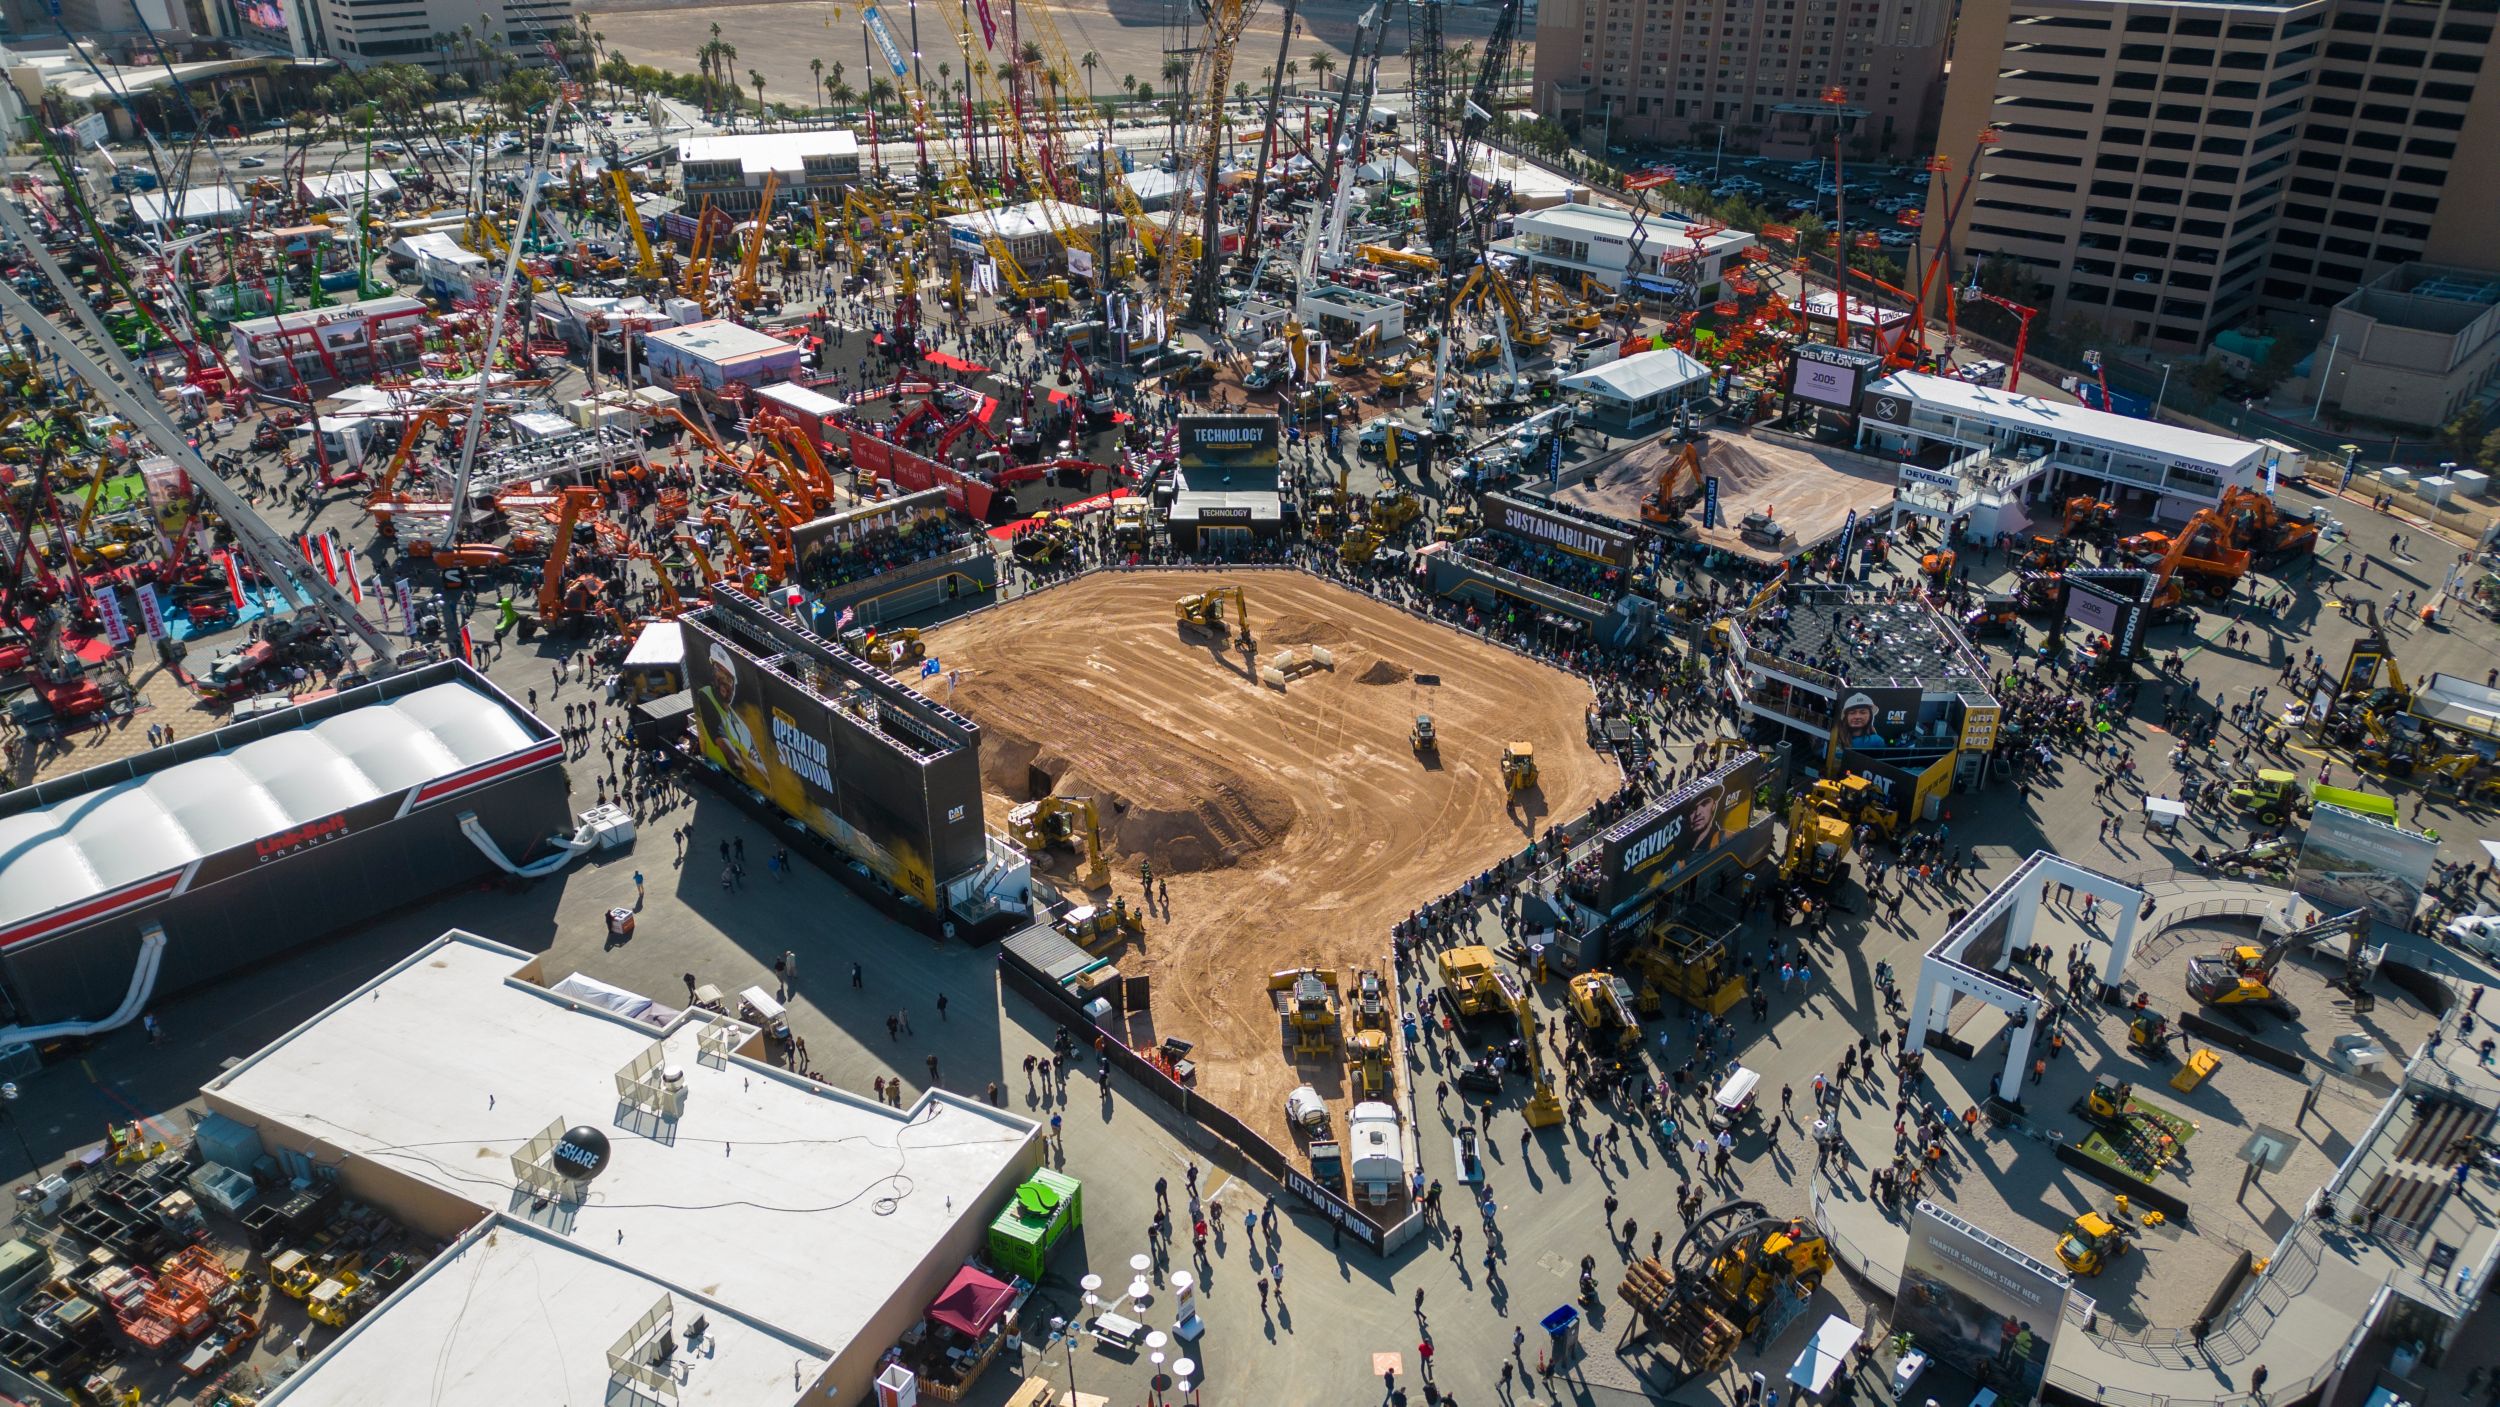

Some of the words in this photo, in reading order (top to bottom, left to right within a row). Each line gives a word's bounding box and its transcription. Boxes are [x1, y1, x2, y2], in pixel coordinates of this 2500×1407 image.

[1594, 235, 1623, 245] LIEBHERR
[1794, 300, 1832, 316] DNGLI
[1800, 350, 1853, 368] DEVELON
[1590, 381, 1608, 393] Altec
[1812, 372, 1836, 385] 2005
[1194, 428, 1263, 442] TECHNOLOGY
[2013, 424, 2053, 438] DEVELON
[1905, 469, 1952, 486] DEVELON
[2174, 460, 2219, 475] DEVELON
[1202, 509, 1248, 517] TECHNOLOGY
[1705, 479, 1716, 527] DEVELON
[1505, 508, 1607, 557] SUSTAINABILITY
[1838, 513, 1855, 563] DEVELON
[99, 594, 121, 641] Link-Belt
[140, 592, 161, 638] Link-Belt
[2082, 601, 2102, 614] 2005
[352, 613, 377, 636] GUAY
[2120, 606, 2140, 657] DOOSAN
[1887, 710, 1907, 721] CAT
[773, 716, 828, 768] OPERATOR
[776, 740, 833, 795] STADIUM
[1725, 790, 1742, 807] CAT
[948, 805, 964, 820] CAT
[255, 815, 346, 857] Link-Belt
[260, 827, 349, 863] CRANES
[1623, 814, 1683, 872] SERVICES
[908, 869, 925, 891] CAT
[1952, 975, 2002, 1000] VOLVO
[554, 1140, 599, 1169] ESHARE
[1289, 1173, 1313, 1200] LET'S
[1313, 1190, 1326, 1210] DO
[1327, 1199, 1344, 1218] THE
[1345, 1211, 1375, 1244] WORK.
[1928, 1236, 1959, 1258] SMARTER
[1961, 1254, 1998, 1280] SOLUTIONS
[1999, 1275, 2021, 1292] START
[2022, 1288, 2042, 1305] HERE.
